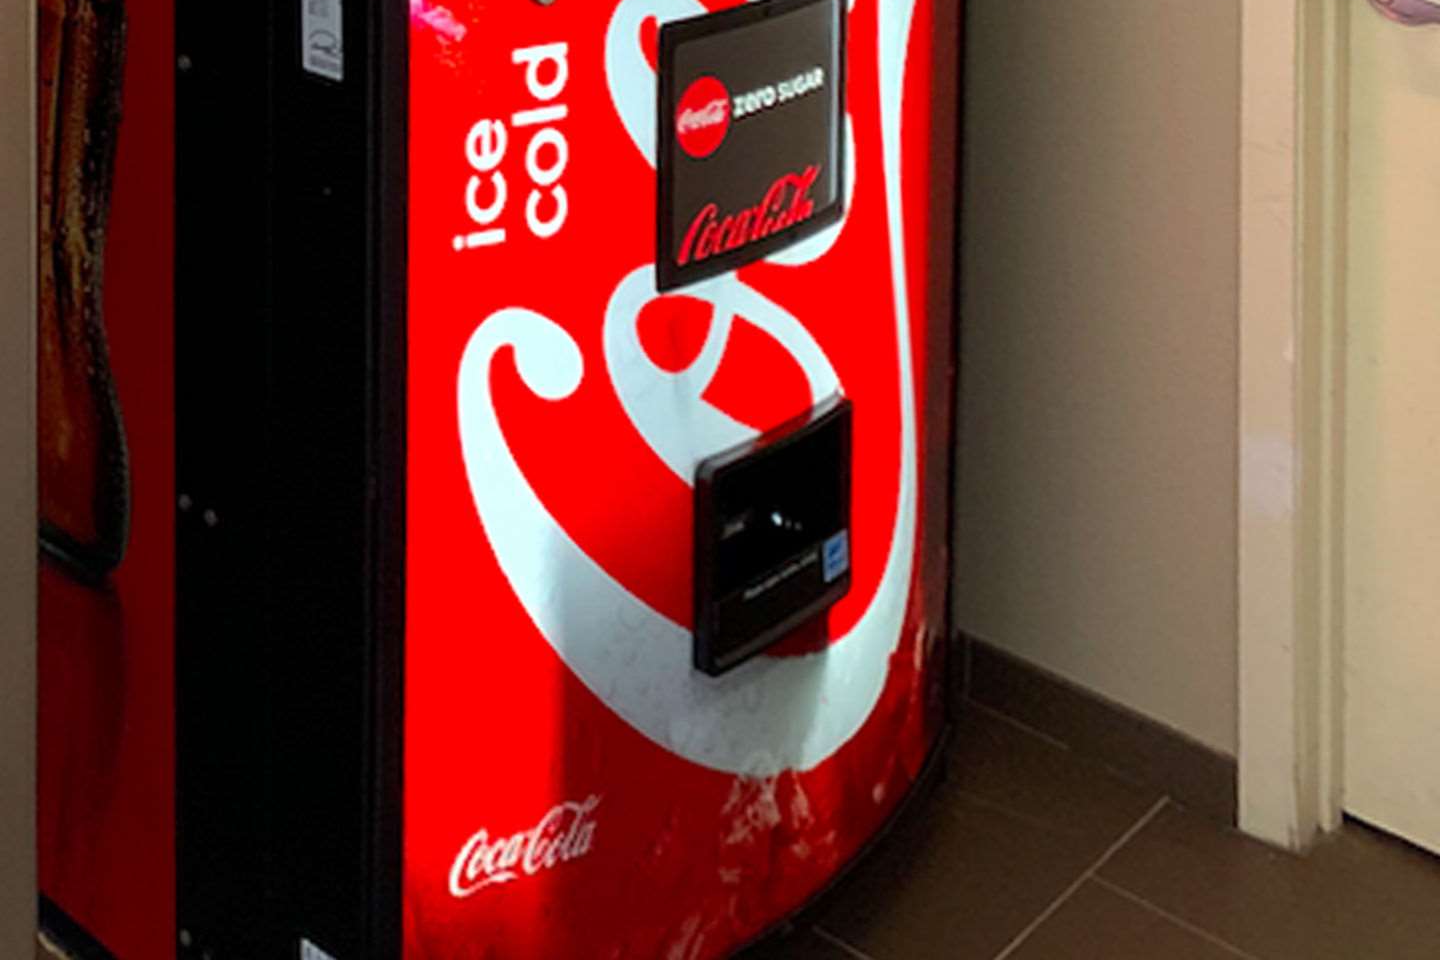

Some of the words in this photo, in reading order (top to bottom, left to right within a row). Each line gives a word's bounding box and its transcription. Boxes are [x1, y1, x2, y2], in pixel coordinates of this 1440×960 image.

[511, 41, 569, 239] cold
[733, 86, 777, 119] zero
[778, 66, 825, 102] SUGAR
[452, 117, 509, 253] ice
[677, 163, 822, 266] Coca-Cola
[449, 793, 605, 899] Coca-Cola
